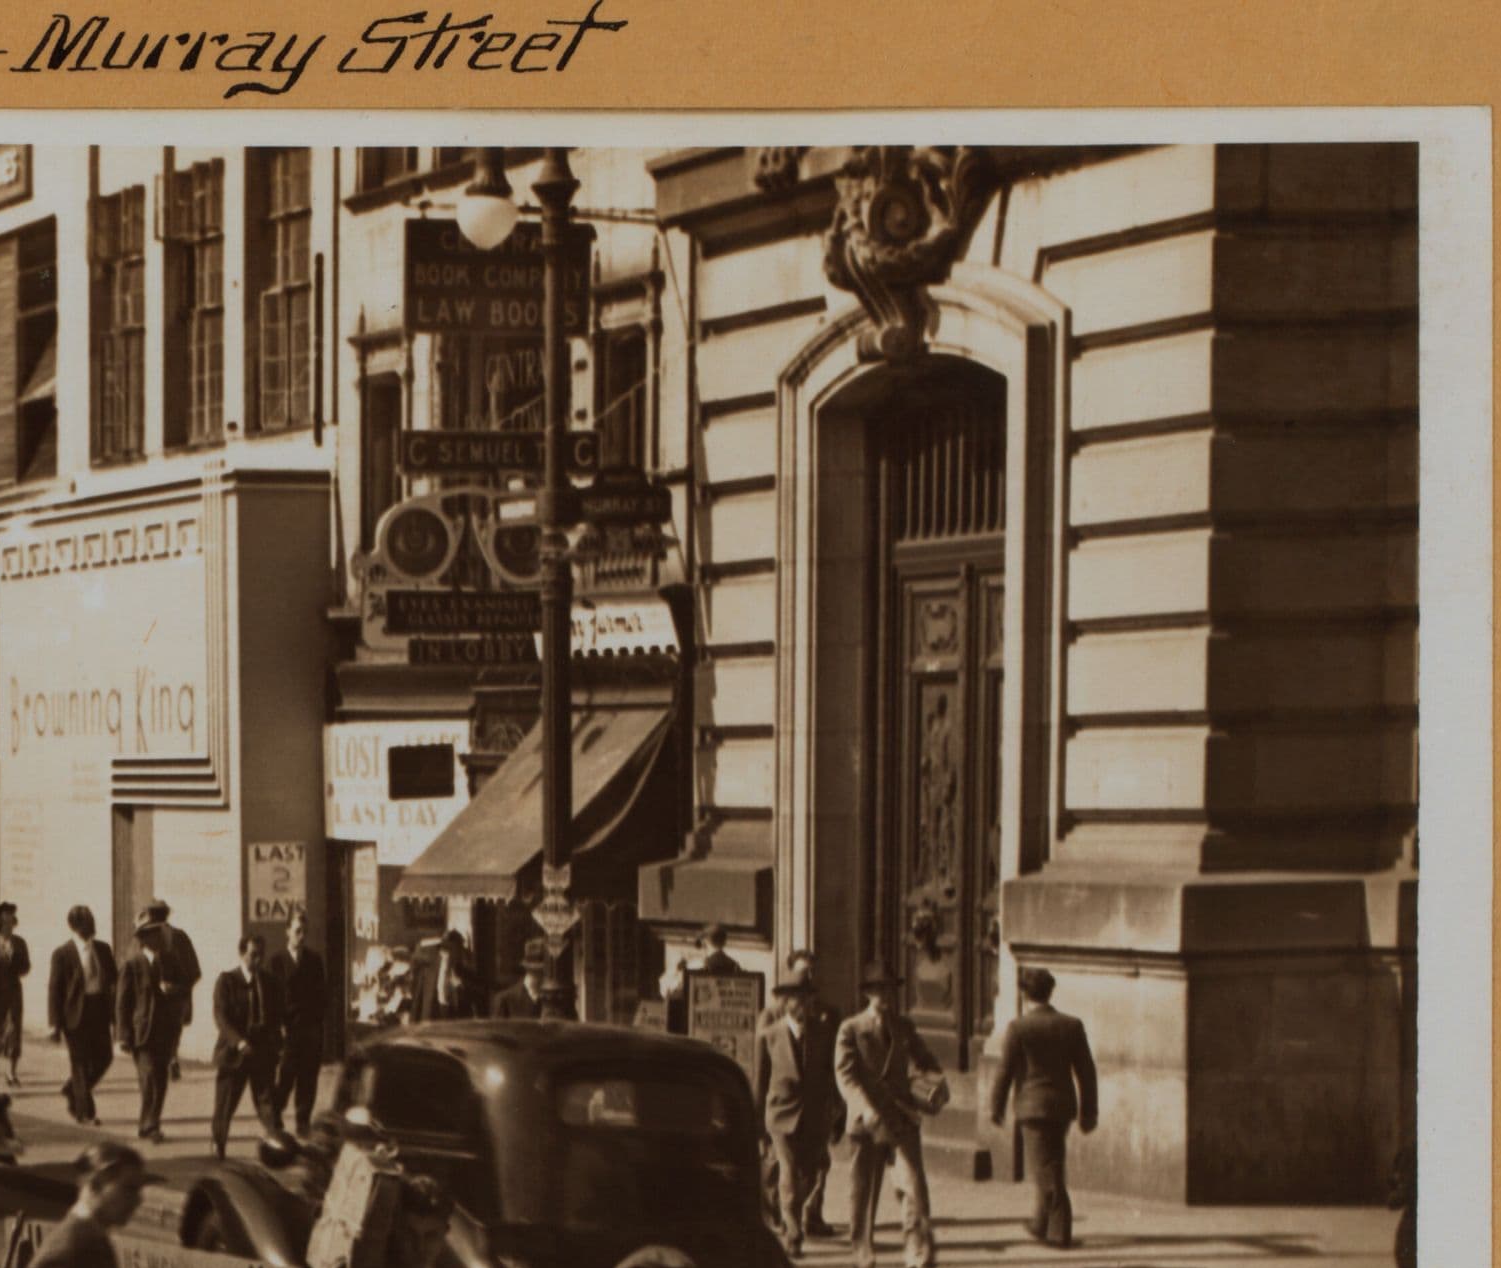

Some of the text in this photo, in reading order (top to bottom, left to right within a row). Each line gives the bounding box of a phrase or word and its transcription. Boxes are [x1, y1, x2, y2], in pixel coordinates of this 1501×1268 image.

[11, 15, 323, 99] Murray
[337, 4, 628, 74] Street
[414, 262, 471, 287] BOOK
[417, 297, 579, 327] LAW BOOS
[9, 665, 198, 757] Browning King
[334, 735, 382, 778] LOST
[334, 802, 383, 826] LAST
[254, 844, 305, 863] LAST
[272, 866, 291, 893] 2
